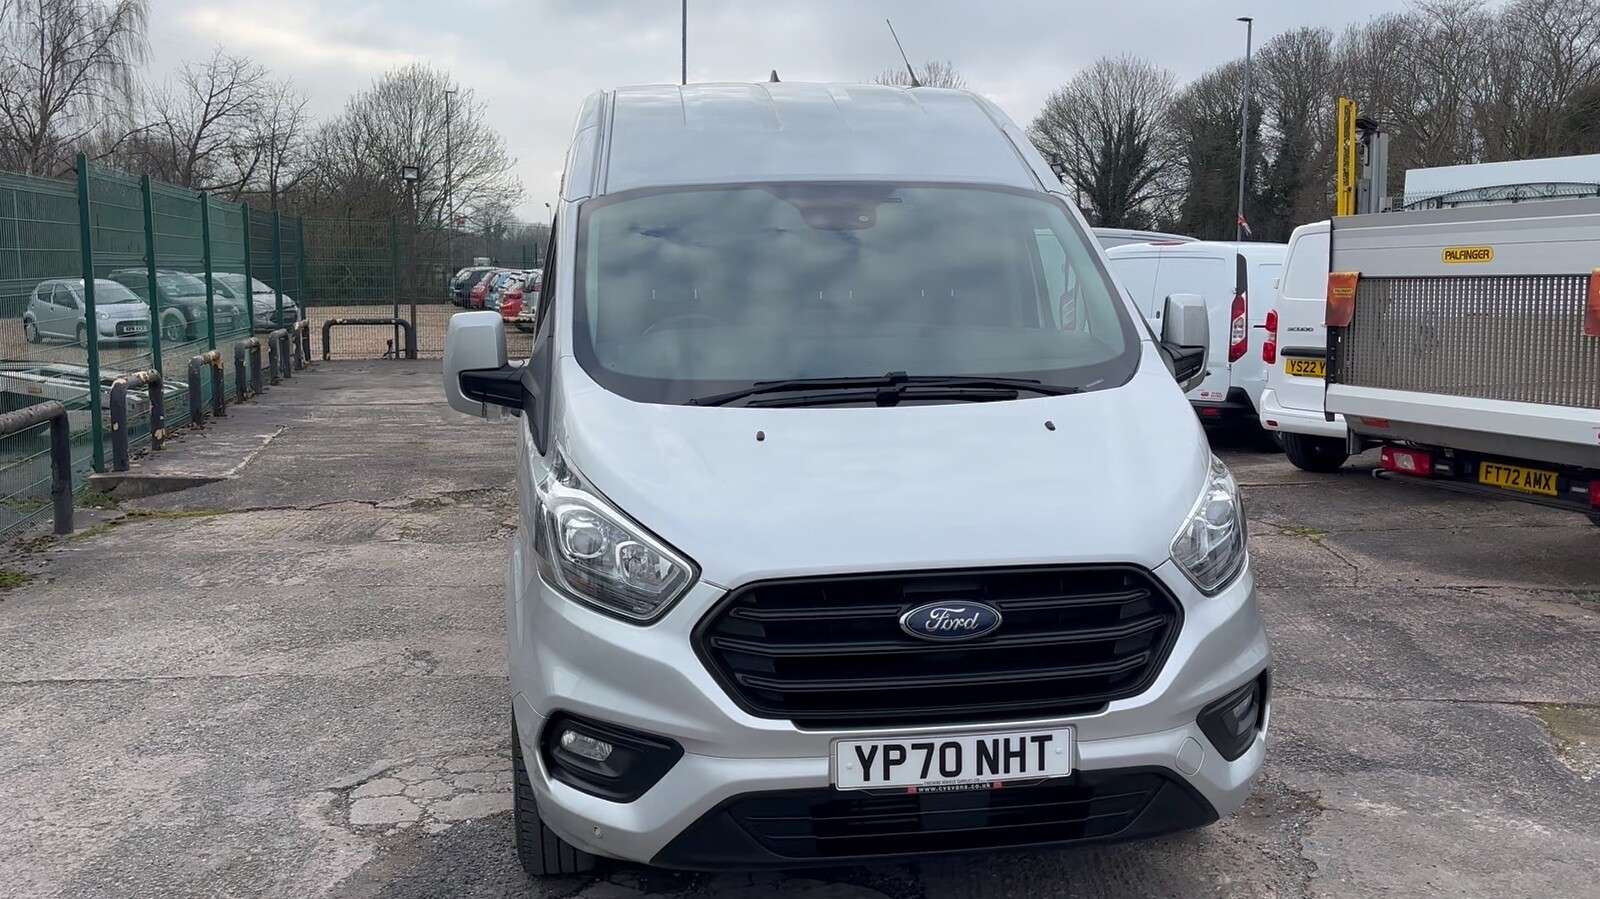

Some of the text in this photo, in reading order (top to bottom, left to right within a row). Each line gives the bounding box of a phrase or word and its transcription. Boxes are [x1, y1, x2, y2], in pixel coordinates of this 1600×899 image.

[1444, 249, 1490, 261] PALFINGER
[1290, 359, 1317, 373] YS22
[1484, 464, 1553, 490] FT72 AMX
[925, 607, 980, 631] Ford
[854, 734, 1053, 782] YP70 NHT
